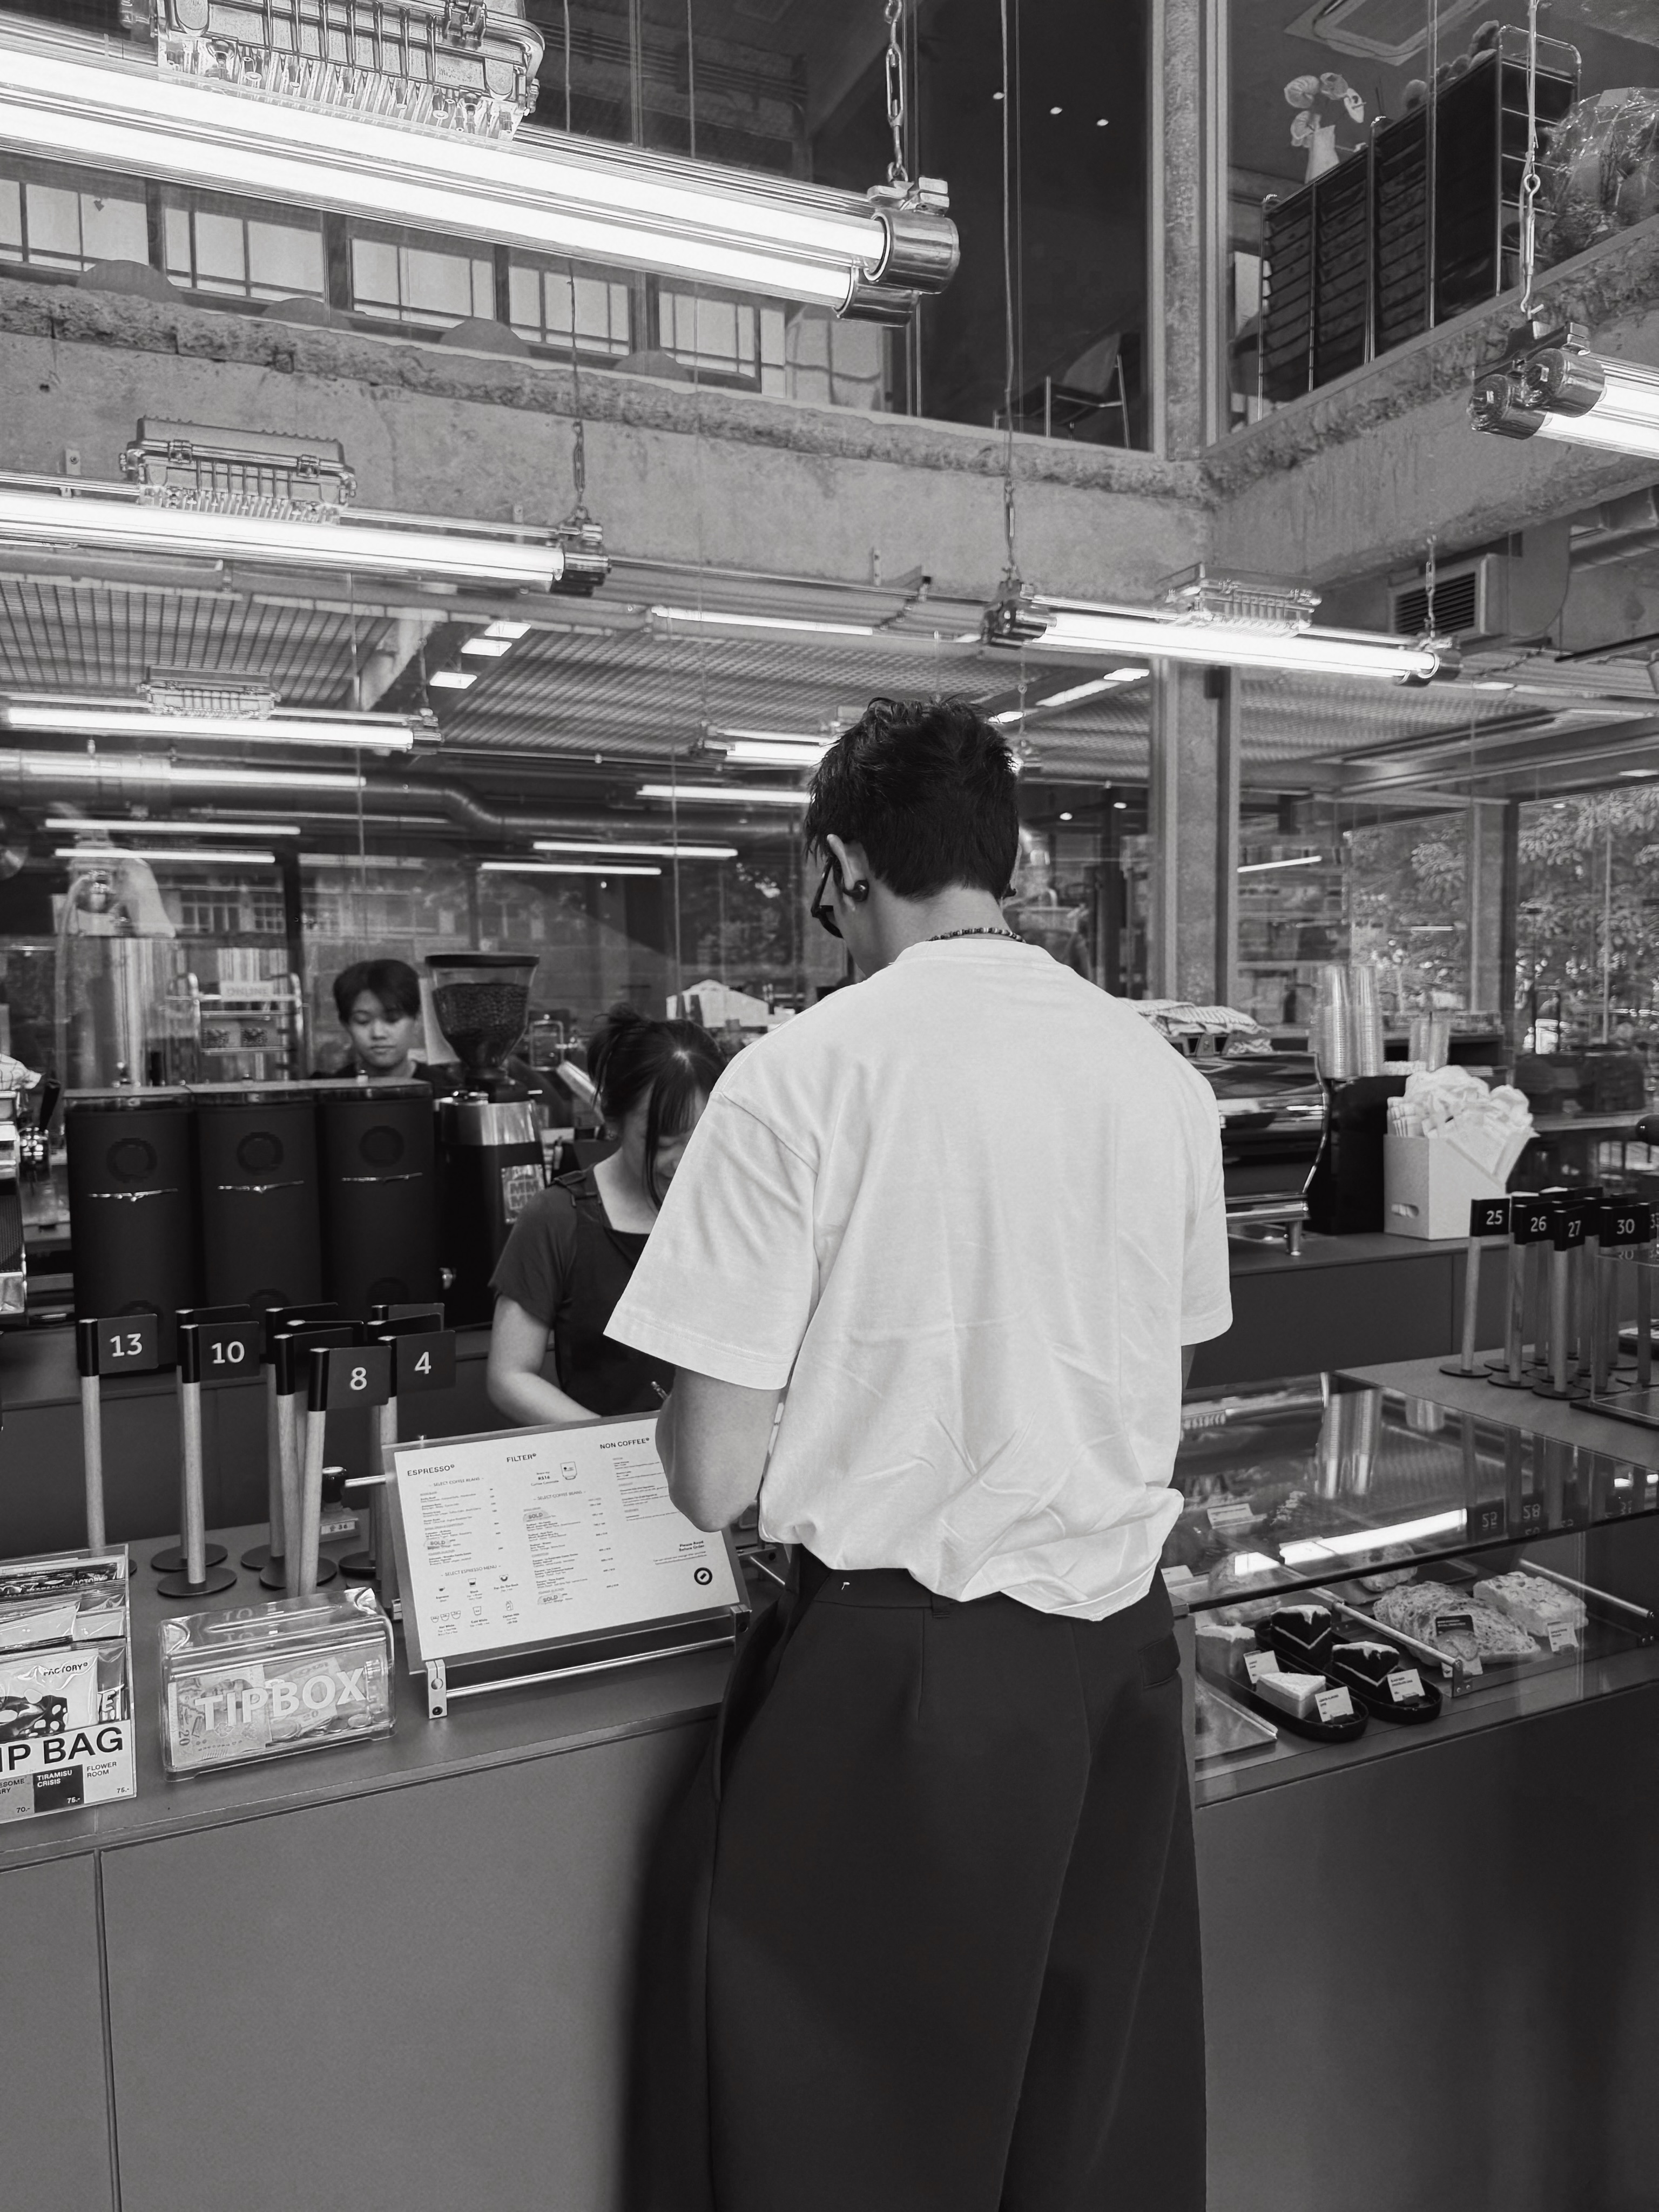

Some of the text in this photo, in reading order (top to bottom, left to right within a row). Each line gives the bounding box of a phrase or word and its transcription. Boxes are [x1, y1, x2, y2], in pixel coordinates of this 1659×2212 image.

[1486, 1210, 1503, 1225] 25
[1530, 1216, 1547, 1232] 26
[1568, 1220, 1581, 1237] 27
[1616, 1218, 1635, 1235] 30
[110, 1333, 143, 1357] 13
[211, 1340, 245, 1364] 10
[414, 1352, 431, 1374] 4
[350, 1367, 367, 1390] 8
[194, 1667, 367, 1731] TIPBOX
[43, 1727, 123, 1764] BAG
[37, 1769, 72, 1781] TIRAMISU
[87, 1761, 117, 1772] FLOWER
[87, 1770, 109, 1778] ROOM
[37, 1778, 61, 1788] CRISIS
